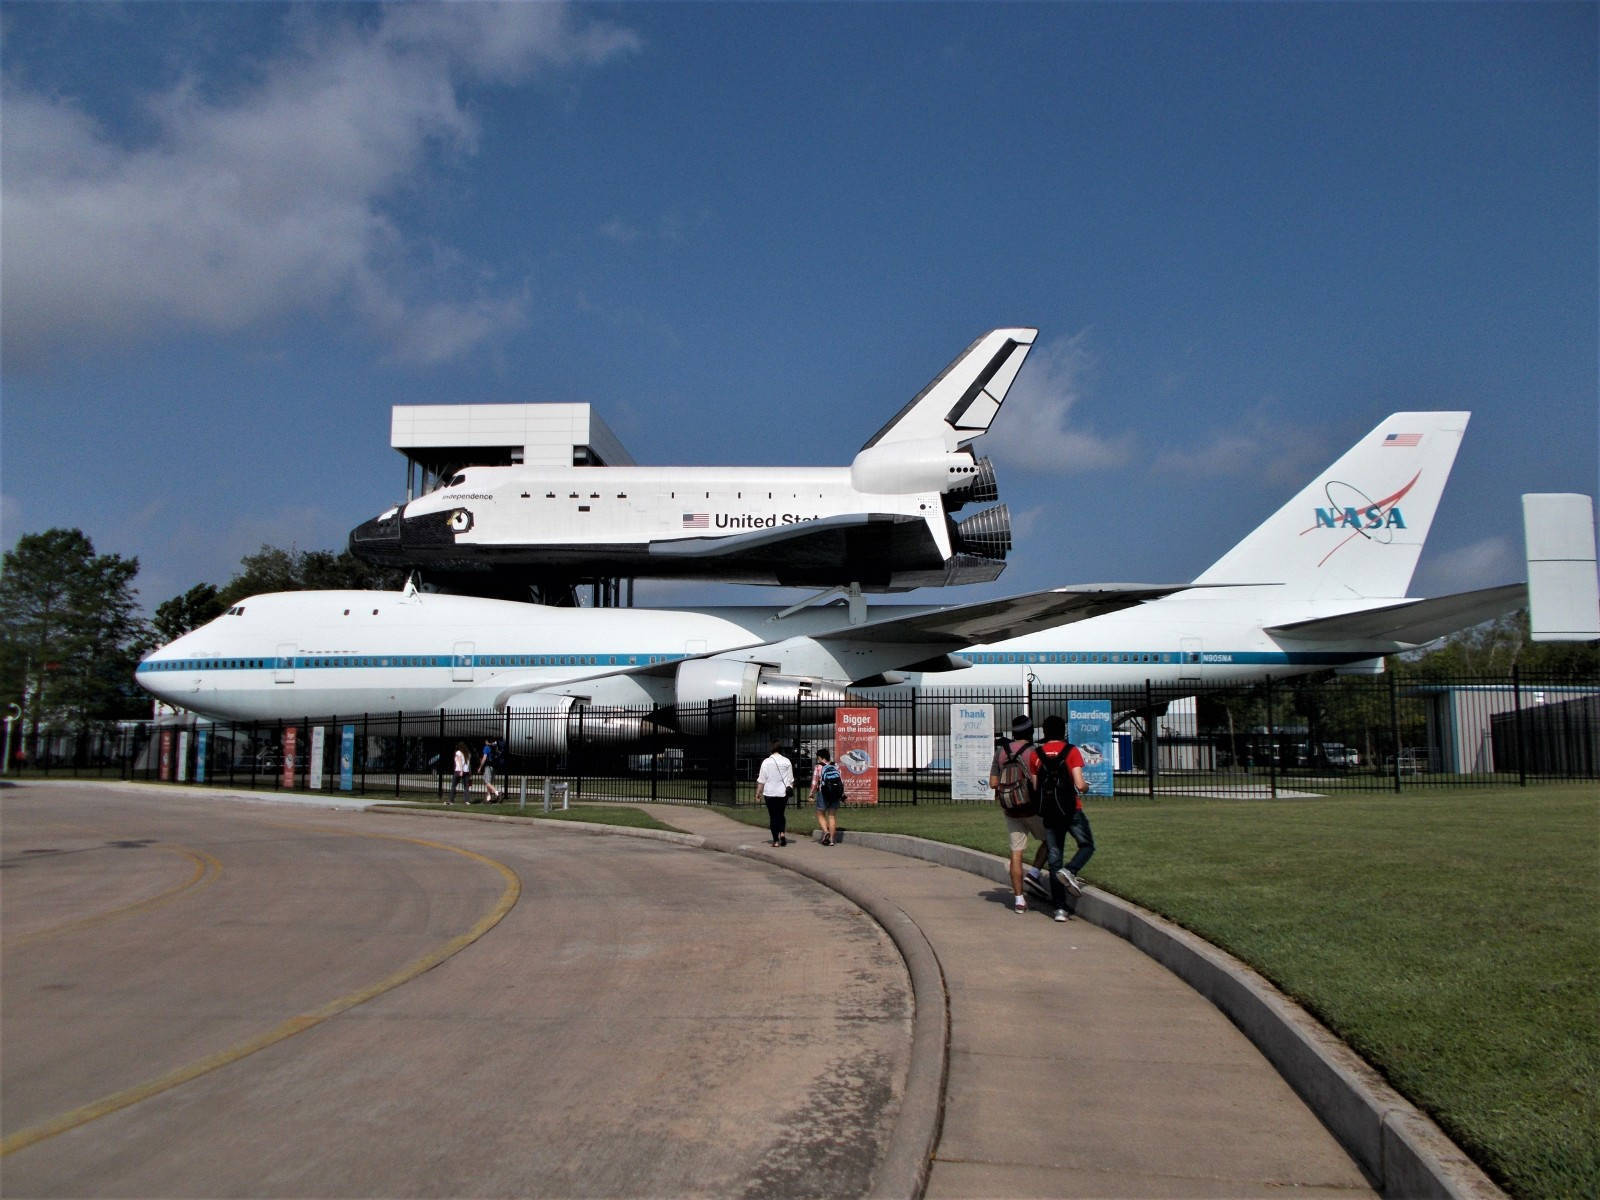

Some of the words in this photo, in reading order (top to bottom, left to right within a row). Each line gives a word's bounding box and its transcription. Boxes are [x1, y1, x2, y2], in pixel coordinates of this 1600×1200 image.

[715, 513, 776, 528] United
[1314, 504, 1407, 529] NASA
[1203, 654, 1232, 662] N905NA
[960, 709, 986, 718] Thank
[1071, 710, 1110, 721] Boarding
[843, 714, 871, 725] Bigger
[1081, 724, 1099, 732] now
